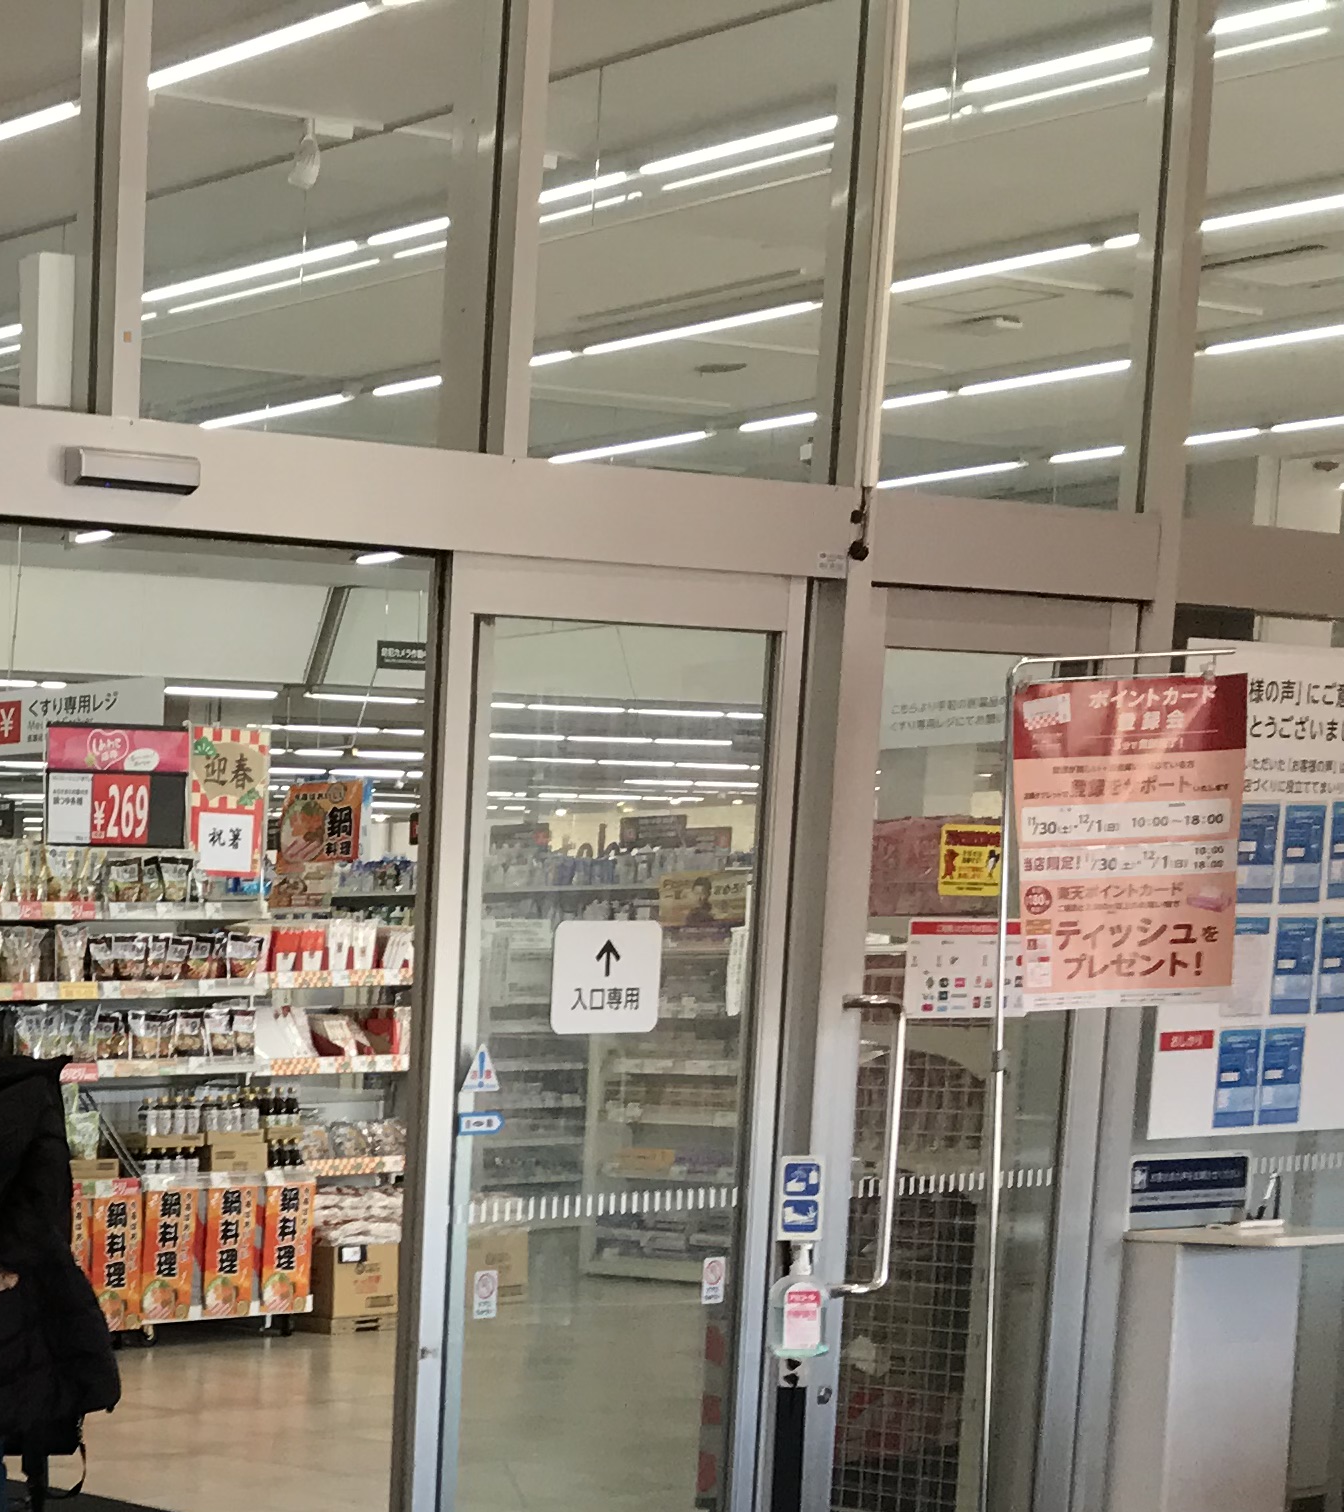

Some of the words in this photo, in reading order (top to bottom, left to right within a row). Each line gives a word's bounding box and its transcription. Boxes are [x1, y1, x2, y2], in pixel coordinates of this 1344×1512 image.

[28, 690, 119, 718] くすり専用レジ
[1088, 685, 1217, 709] ポイントカード
[204, 752, 254, 791] 迎春
[106, 784, 150, 838] 269
[325, 806, 352, 838] 鍋
[1055, 917, 1219, 951] ティッシュを
[1064, 950, 1203, 979] プレゼント!
[570, 986, 640, 1011] 入口専用
[105, 1202, 128, 1288] 鍋料理
[155, 1191, 182, 1278] 鍋料理
[217, 1189, 242, 1275] 鍋料理
[275, 1187, 300, 1271] 鍋料理
